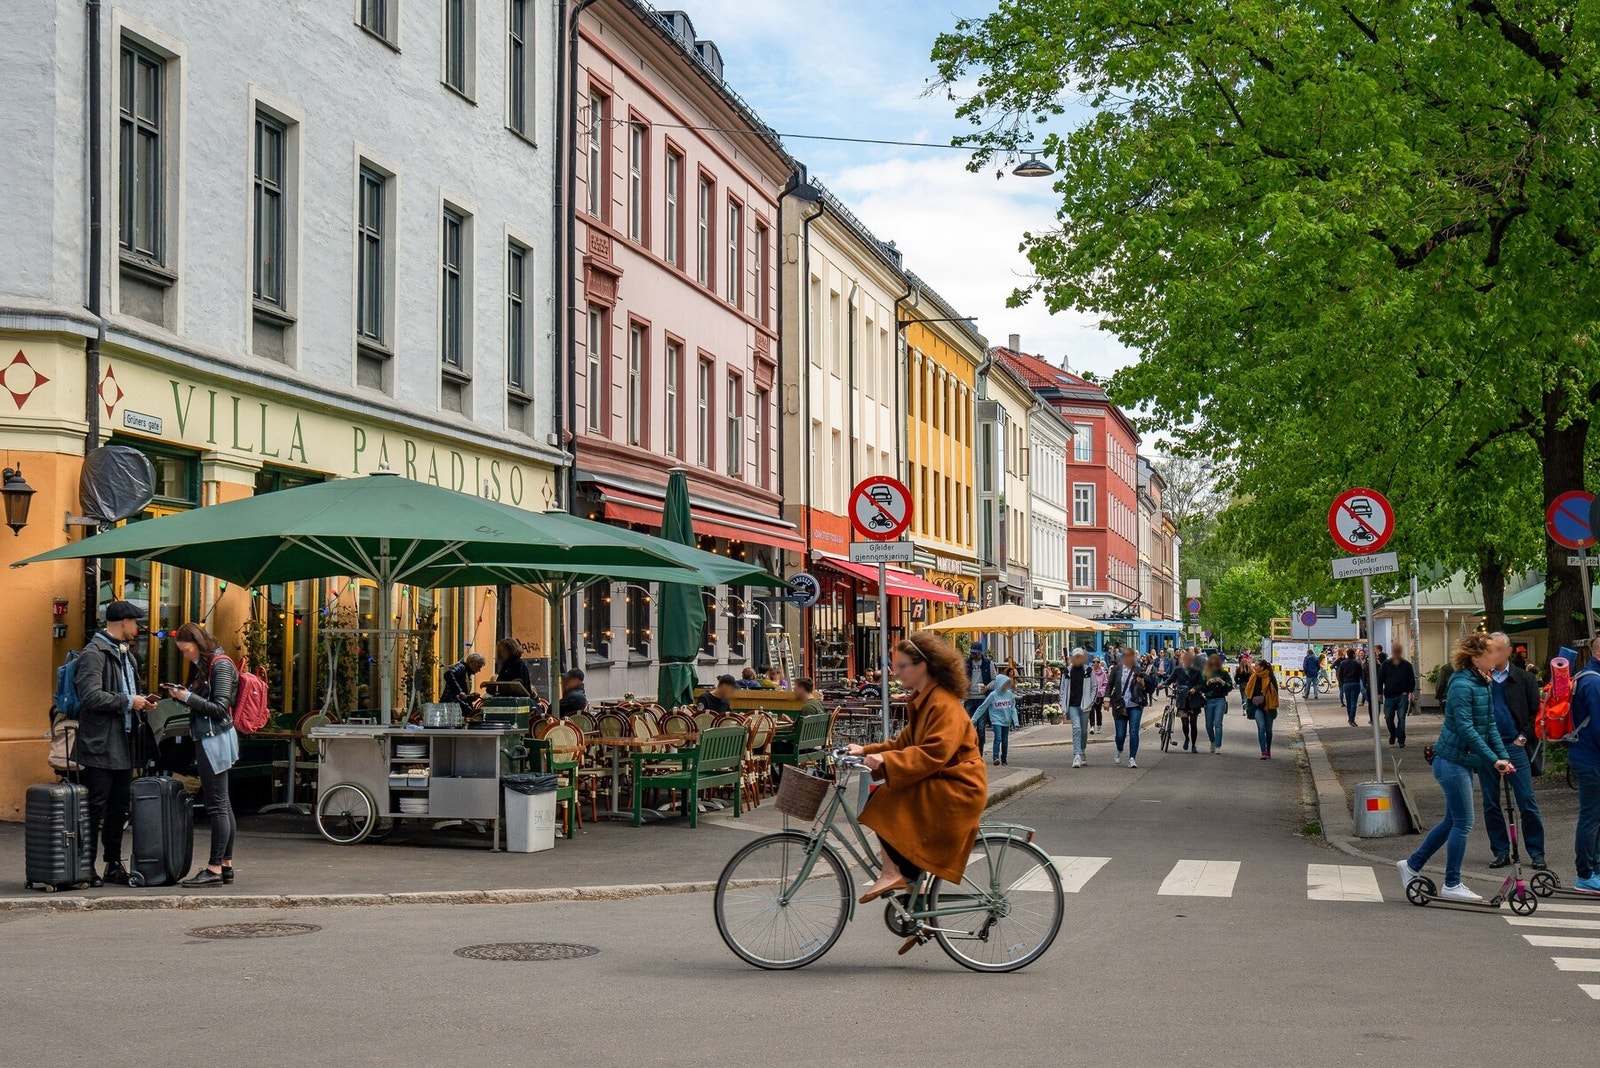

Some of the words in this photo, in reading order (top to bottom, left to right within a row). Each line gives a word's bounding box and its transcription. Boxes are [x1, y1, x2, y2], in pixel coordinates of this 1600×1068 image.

[126, 414, 147, 428] Grüners
[148, 420, 160, 431] gate
[169, 380, 308, 464] VILLA
[352, 426, 523, 506] PARADISO
[869, 544, 894, 552] Gjelder
[855, 553, 909, 561] gjennomkjøring
[1352, 556, 1377, 566] Gjelder
[1338, 564, 1394, 577] gjennomkjøring
